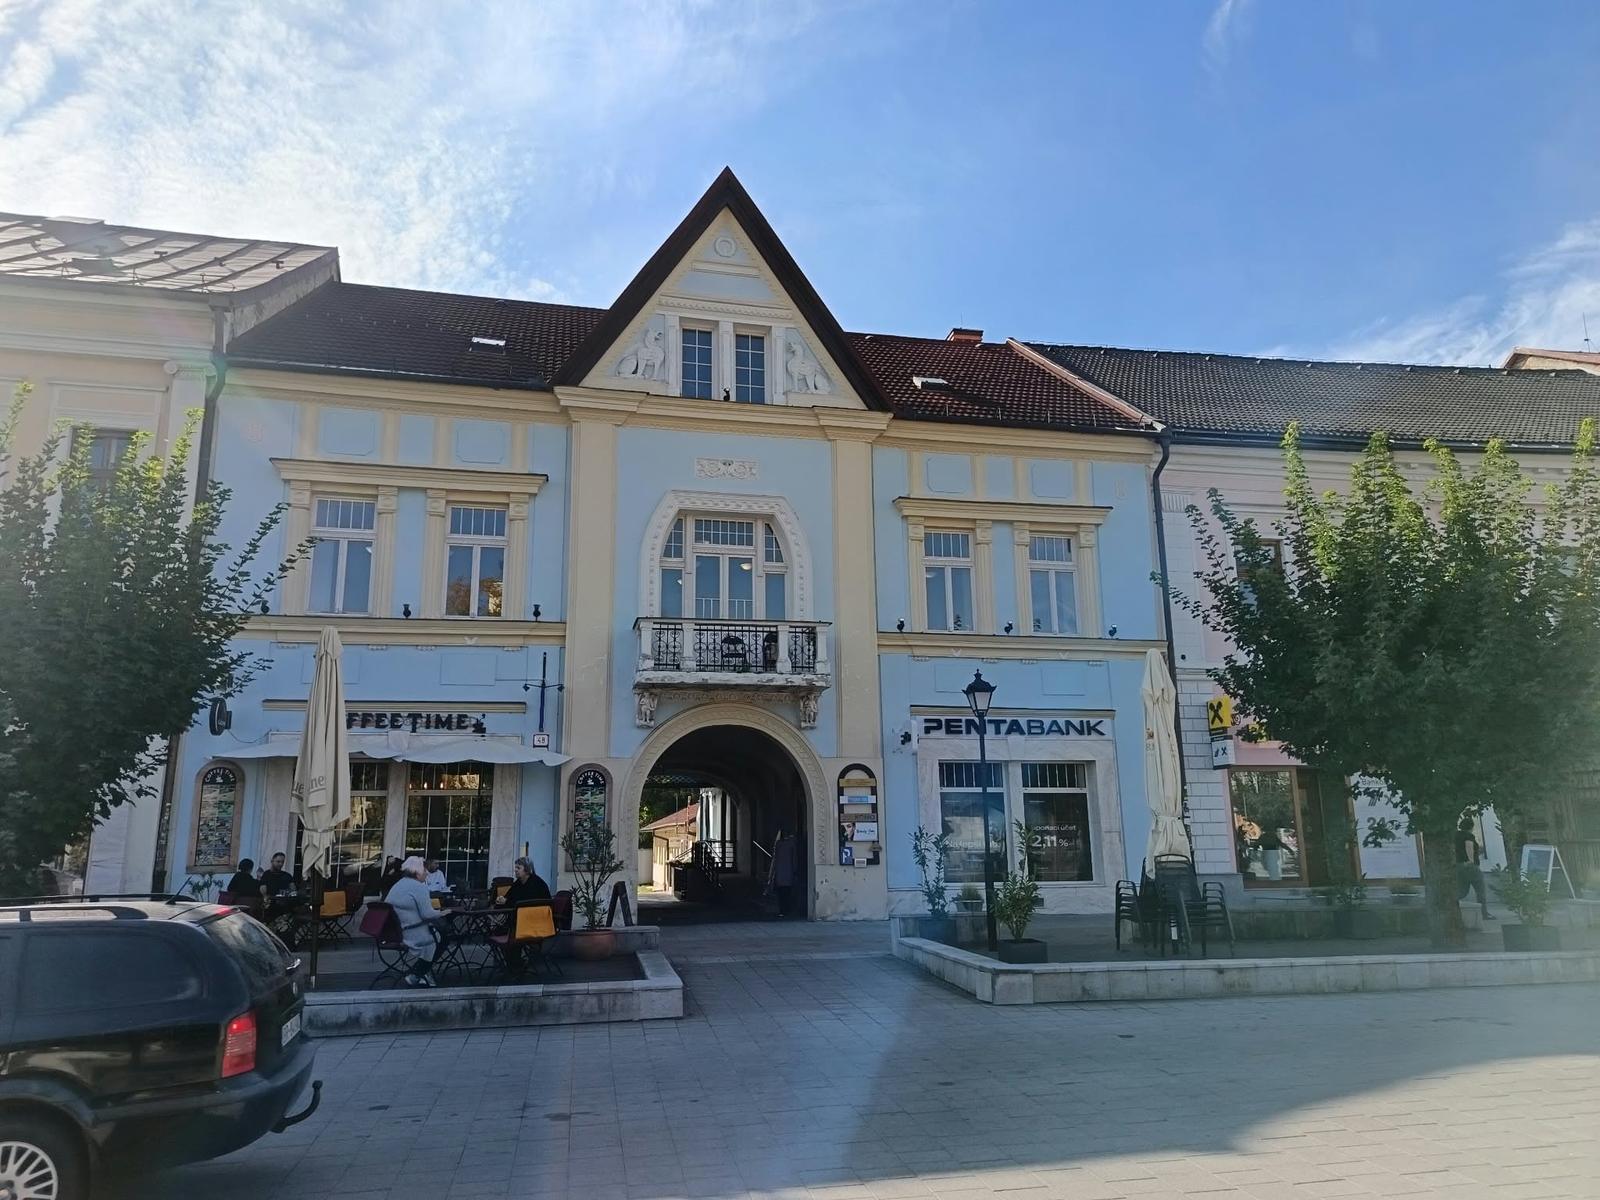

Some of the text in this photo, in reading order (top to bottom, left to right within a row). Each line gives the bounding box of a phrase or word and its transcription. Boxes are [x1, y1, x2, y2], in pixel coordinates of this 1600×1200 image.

[345, 712, 469, 734] FFEE TIME
[923, 718, 1106, 737] PENTABANK
[1032, 835, 1057, 848] 2,11
